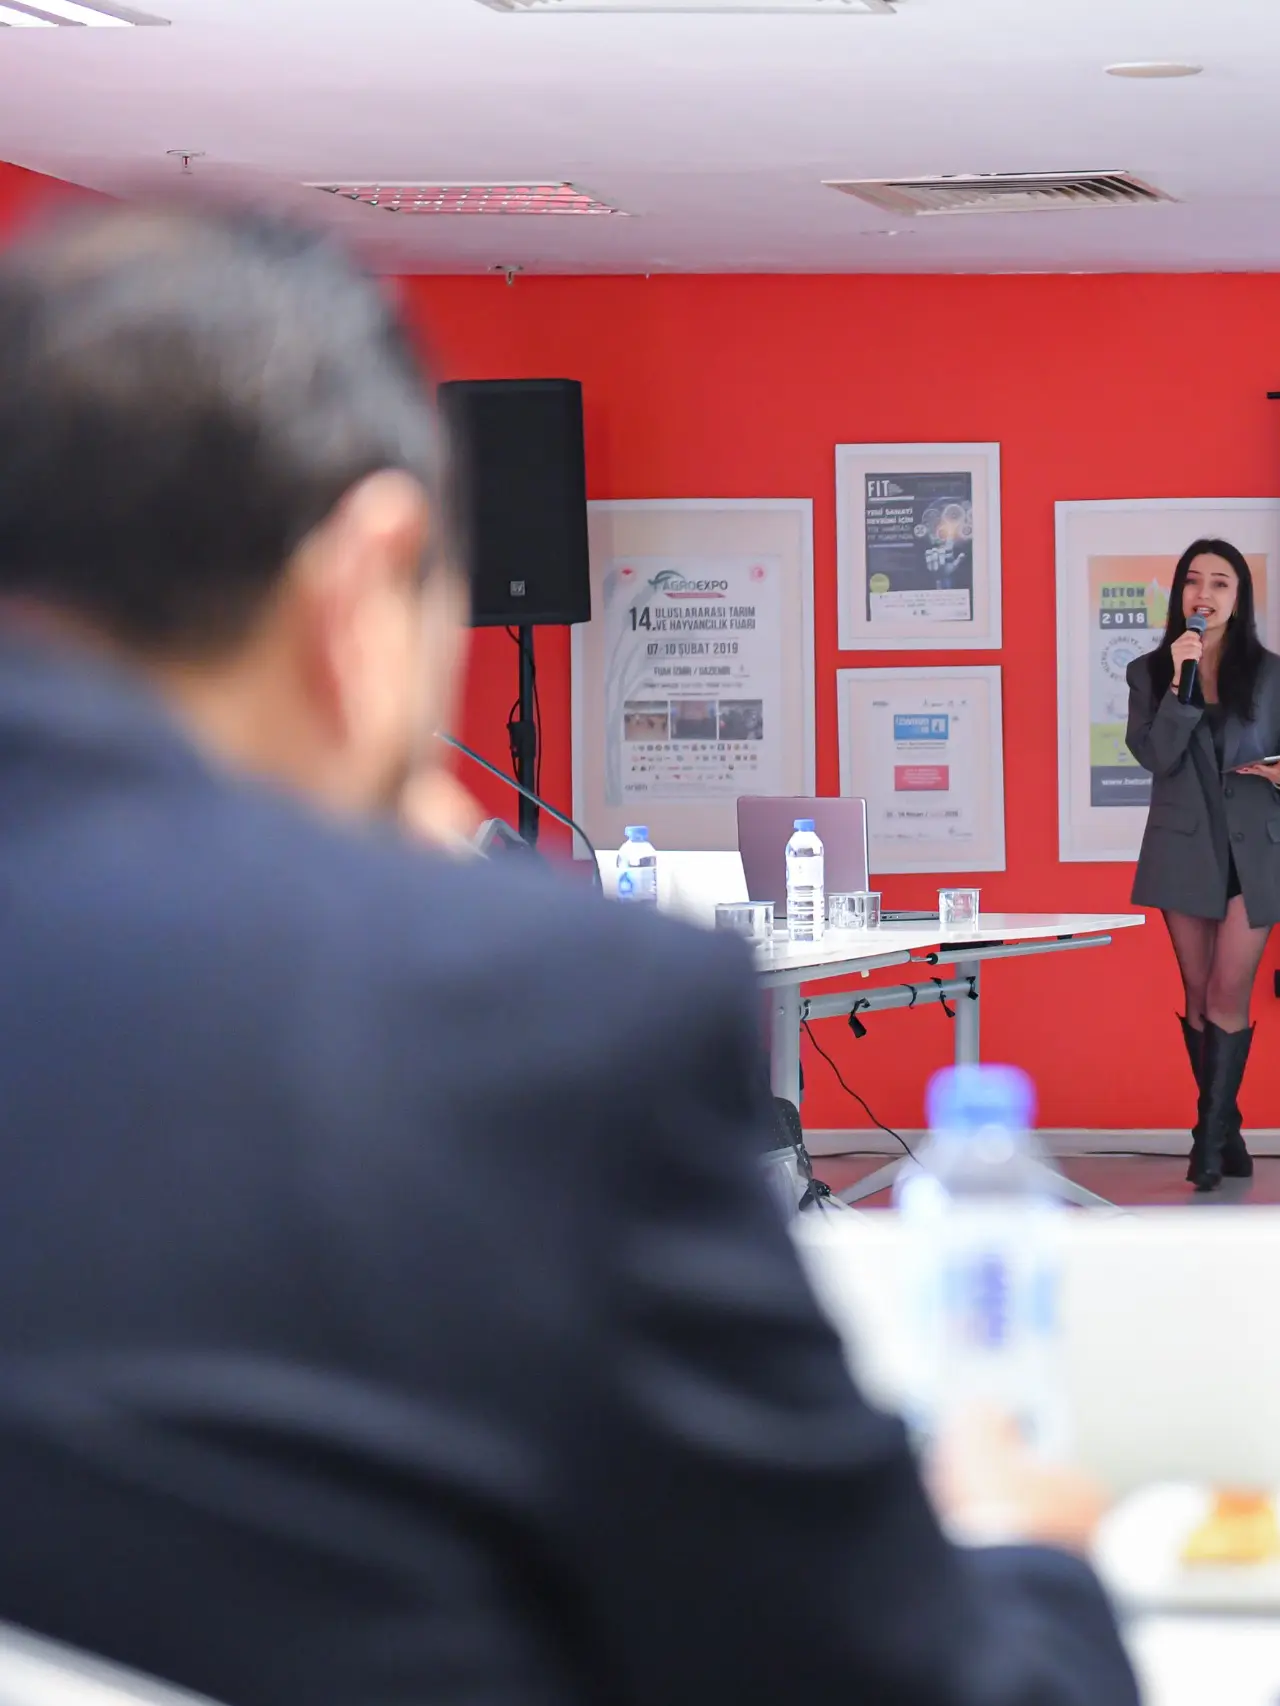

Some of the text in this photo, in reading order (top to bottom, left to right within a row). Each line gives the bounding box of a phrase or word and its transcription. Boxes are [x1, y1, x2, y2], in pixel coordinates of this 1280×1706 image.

[868, 480, 890, 497] FIT
[662, 580, 728, 591] AGROEXPO
[629, 606, 755, 632] 14. ULUSLARARASI TARIM
[656, 618, 756, 631] VE HAYVANCILIK FUARI
[1102, 612, 1145, 624] 2018
[713, 642, 739, 655] 2019
